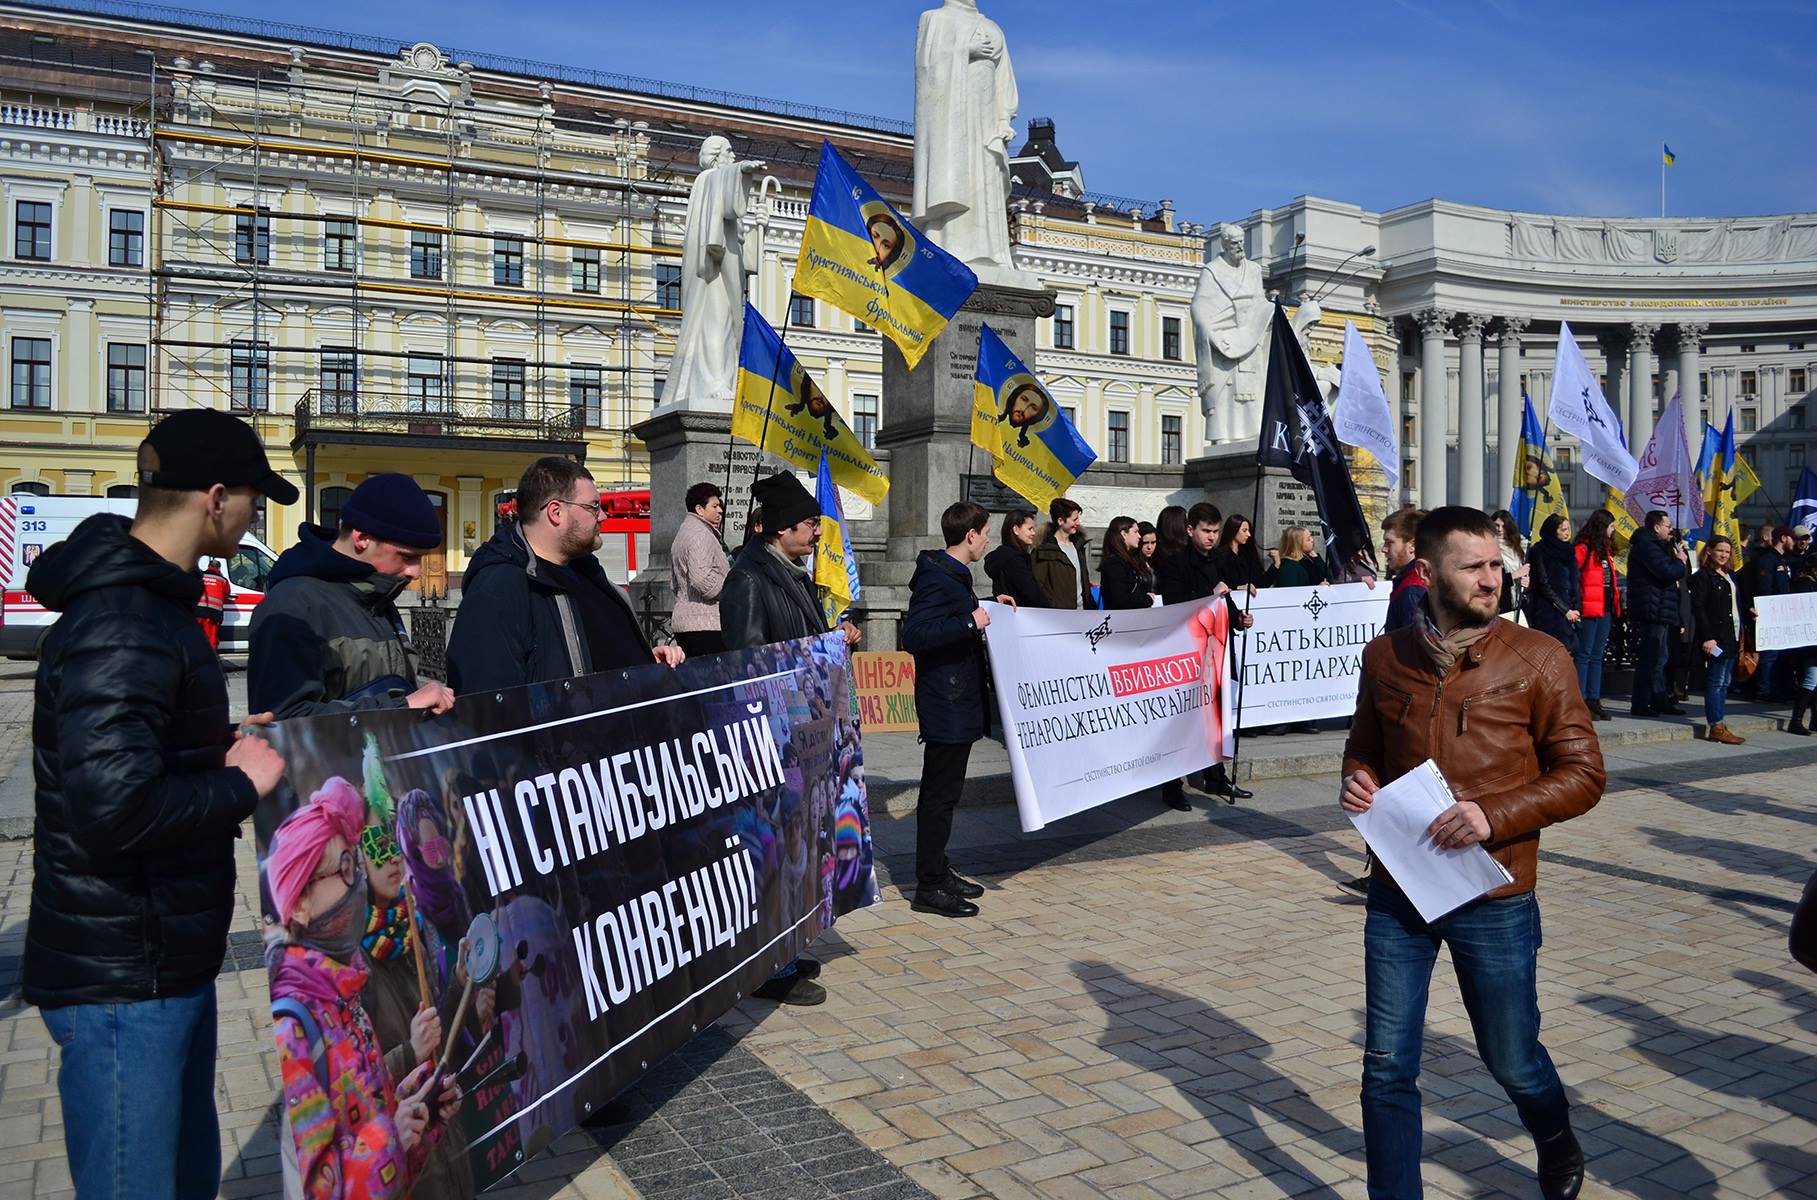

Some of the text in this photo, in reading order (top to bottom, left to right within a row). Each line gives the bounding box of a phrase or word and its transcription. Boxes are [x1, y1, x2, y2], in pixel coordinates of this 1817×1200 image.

[1560, 297, 1788, 309] МІНІСТЕРСТВО ЗАКОРДОННИХ СПРАВ УКРАЇНИ
[783, 437, 818, 462] Фронт
[21, 520, 47, 532] 313
[1110, 655, 1202, 695] ВБИВАЮТЬ
[1135, 683, 1216, 725] УКРАЇНЦІВ!
[1267, 697, 1316, 709] СЕСТРИНСТВО
[463, 700, 786, 898] НІ СТАМБУЛЬСЬКІЙ
[572, 836, 760, 1022] КОНВЕНЦІЇ!
